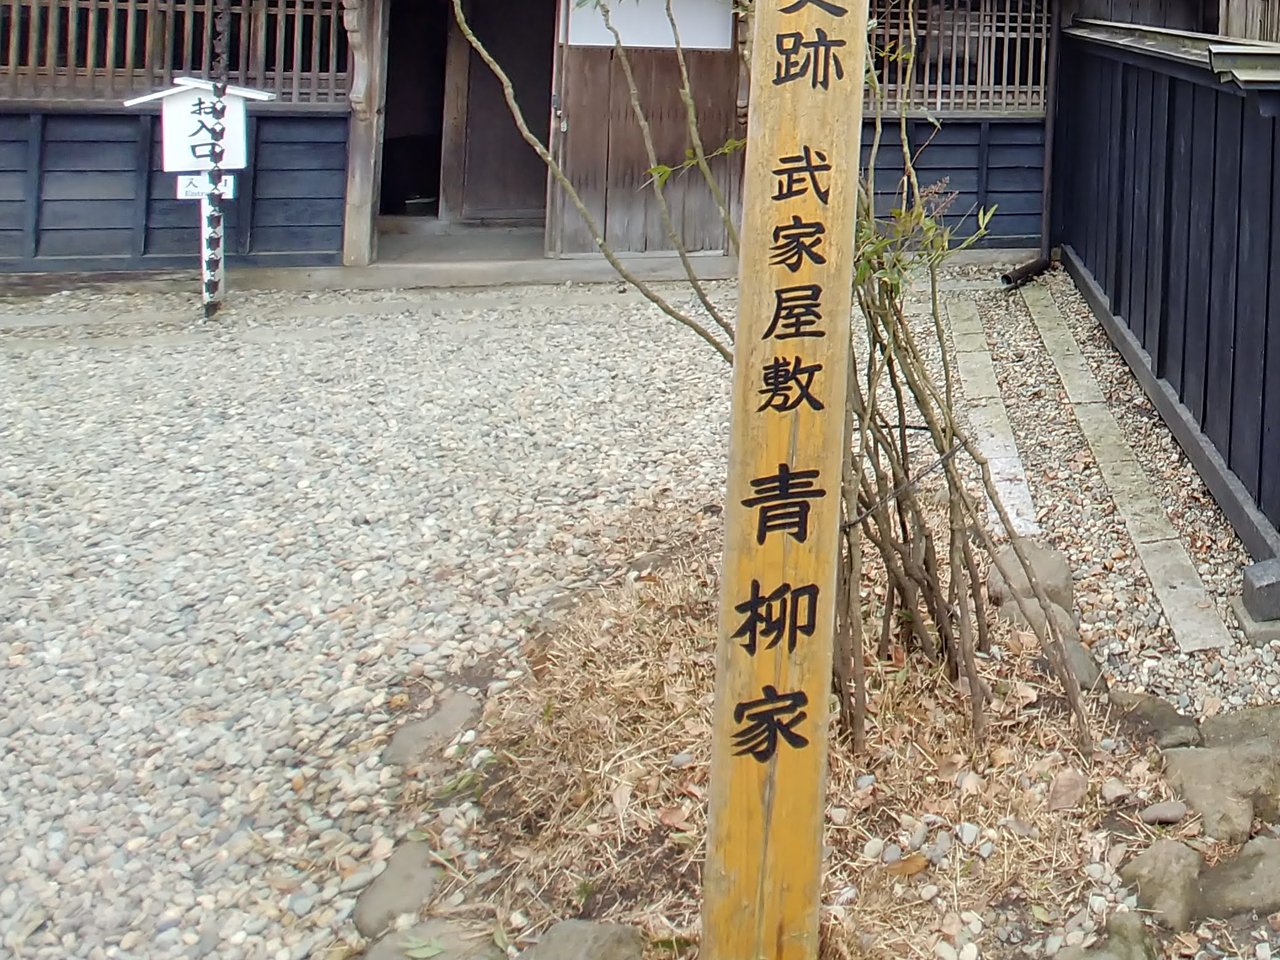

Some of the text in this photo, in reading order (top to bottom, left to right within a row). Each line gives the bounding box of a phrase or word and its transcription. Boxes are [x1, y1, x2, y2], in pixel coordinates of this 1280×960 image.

[755, 145, 832, 414] 武家屋敷
[729, 463, 827, 765] 青柳家
